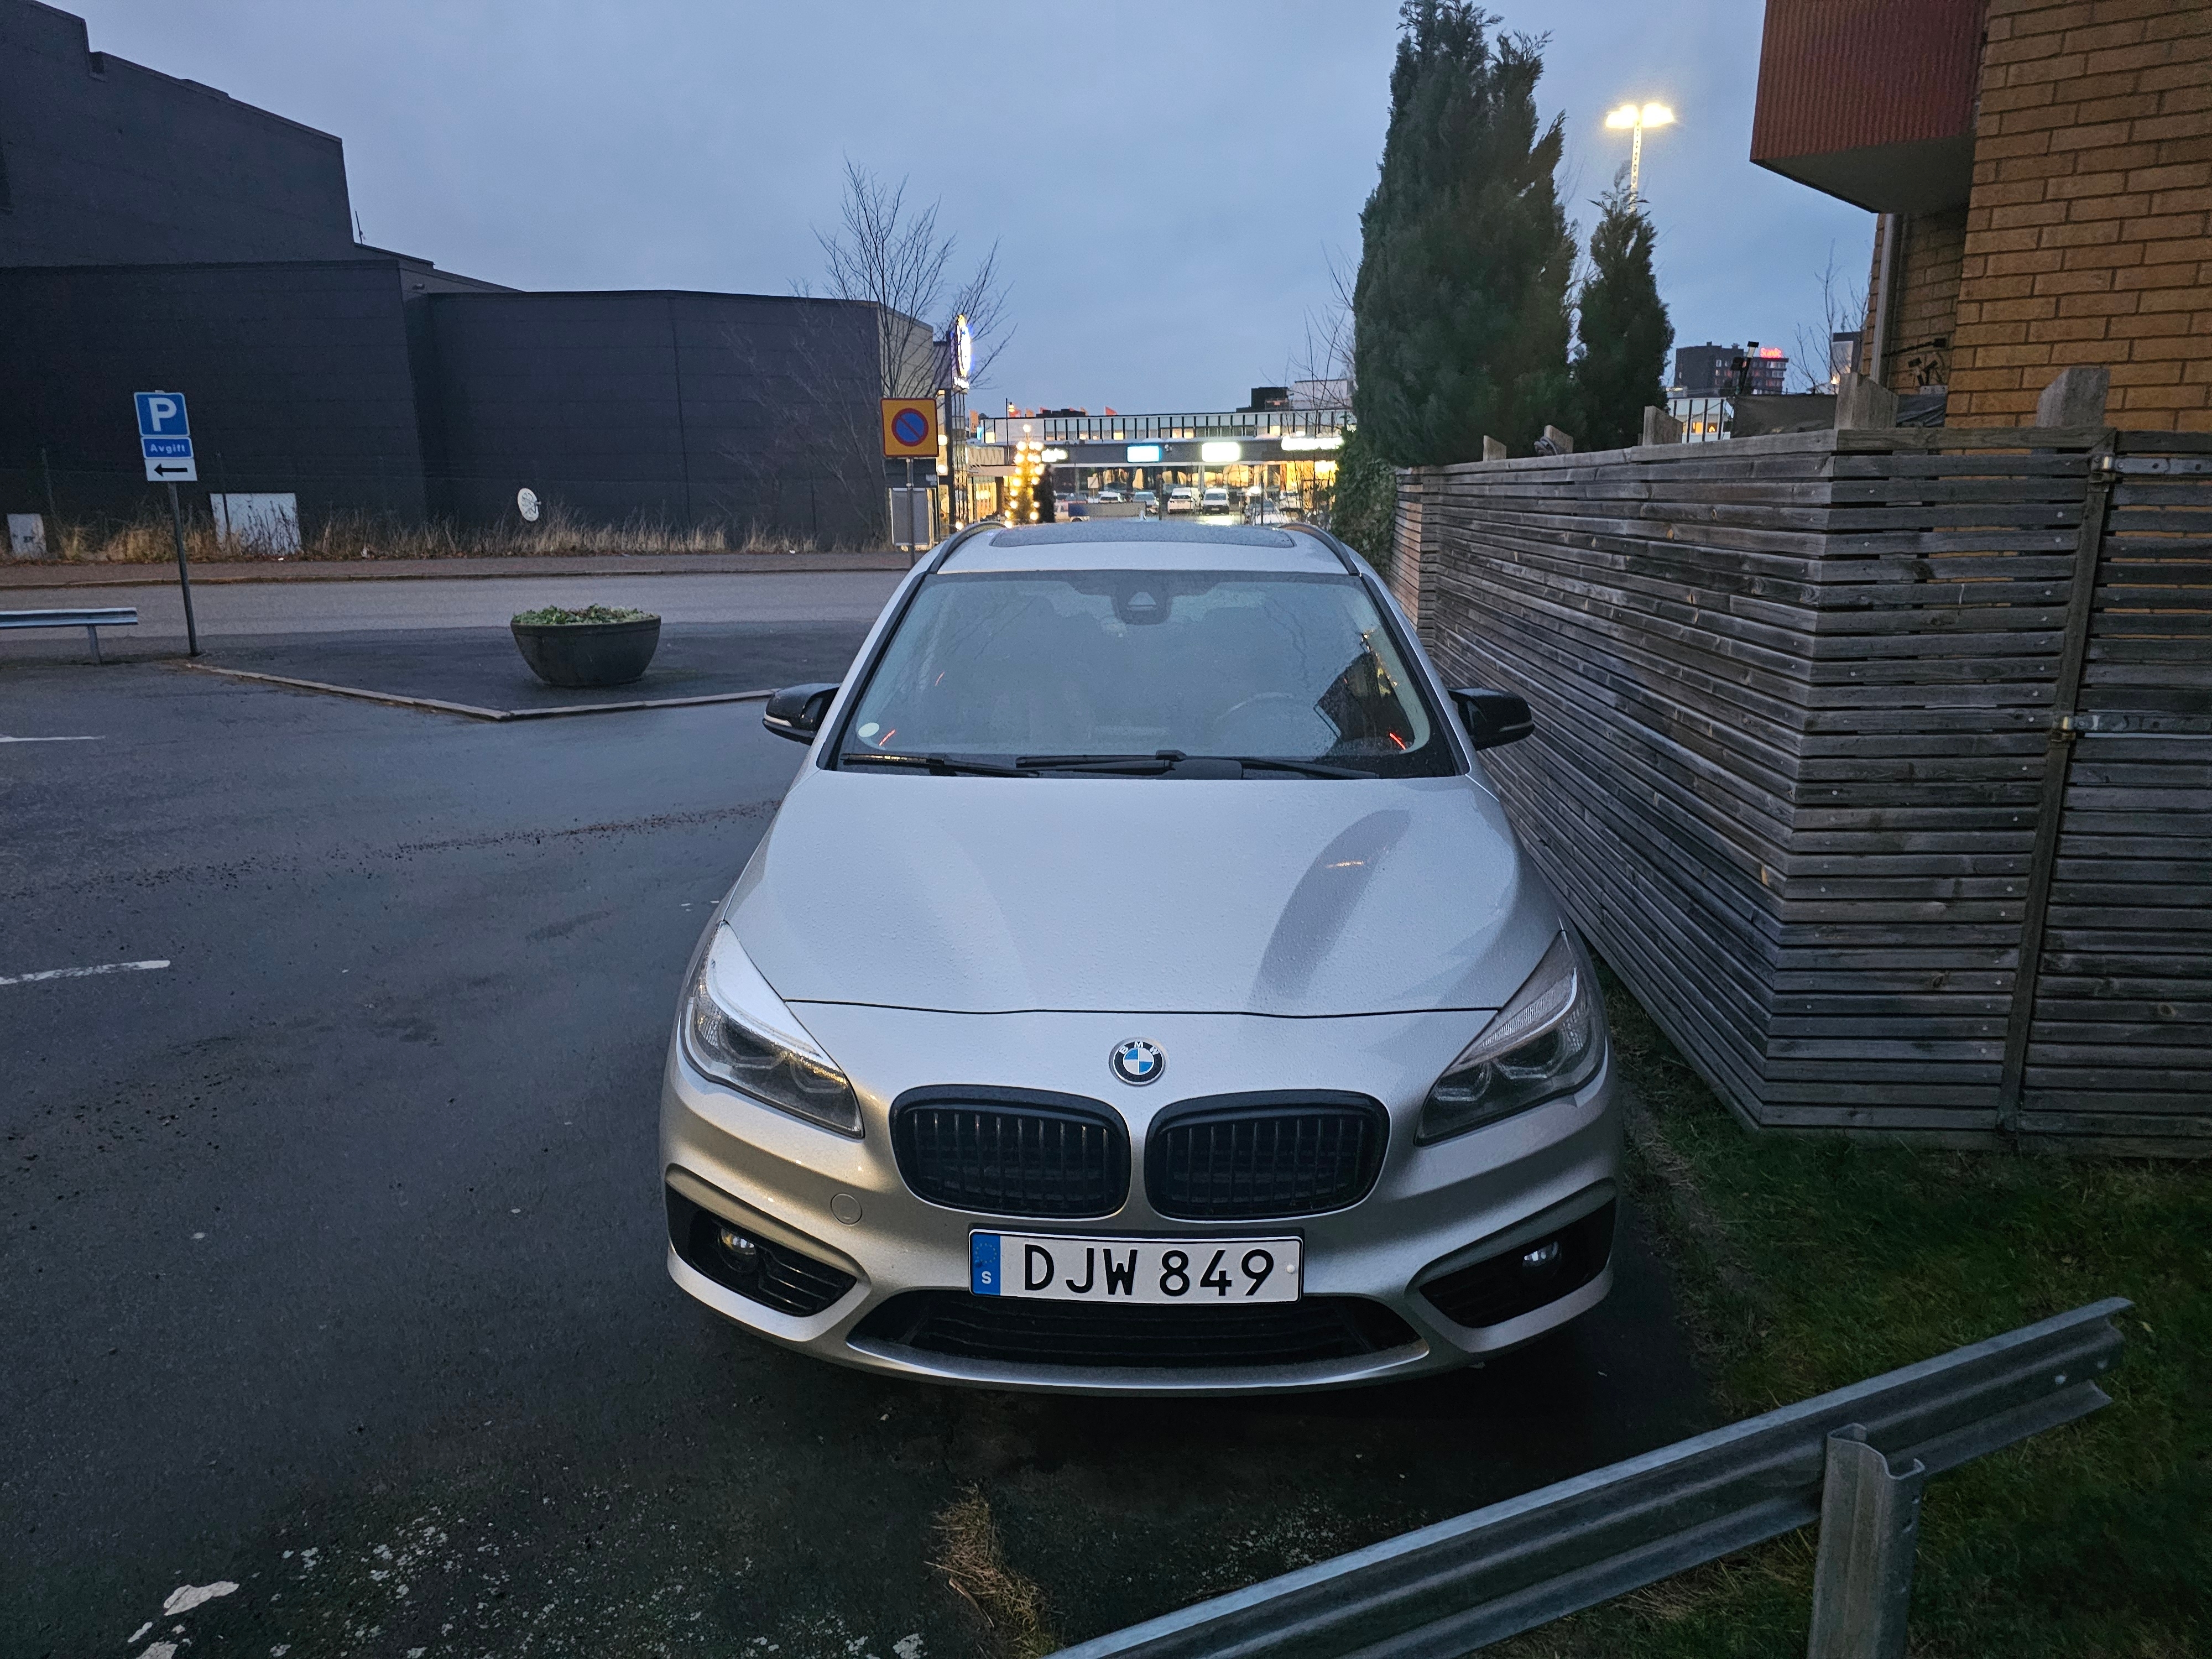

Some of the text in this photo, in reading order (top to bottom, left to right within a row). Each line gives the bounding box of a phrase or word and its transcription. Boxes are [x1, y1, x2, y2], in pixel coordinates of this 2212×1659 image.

[148, 398, 177, 431] P
[150, 444, 185, 454] Avgift
[1119, 1041, 1160, 1055] BMW
[981, 1244, 1274, 1296] S DJW 849
